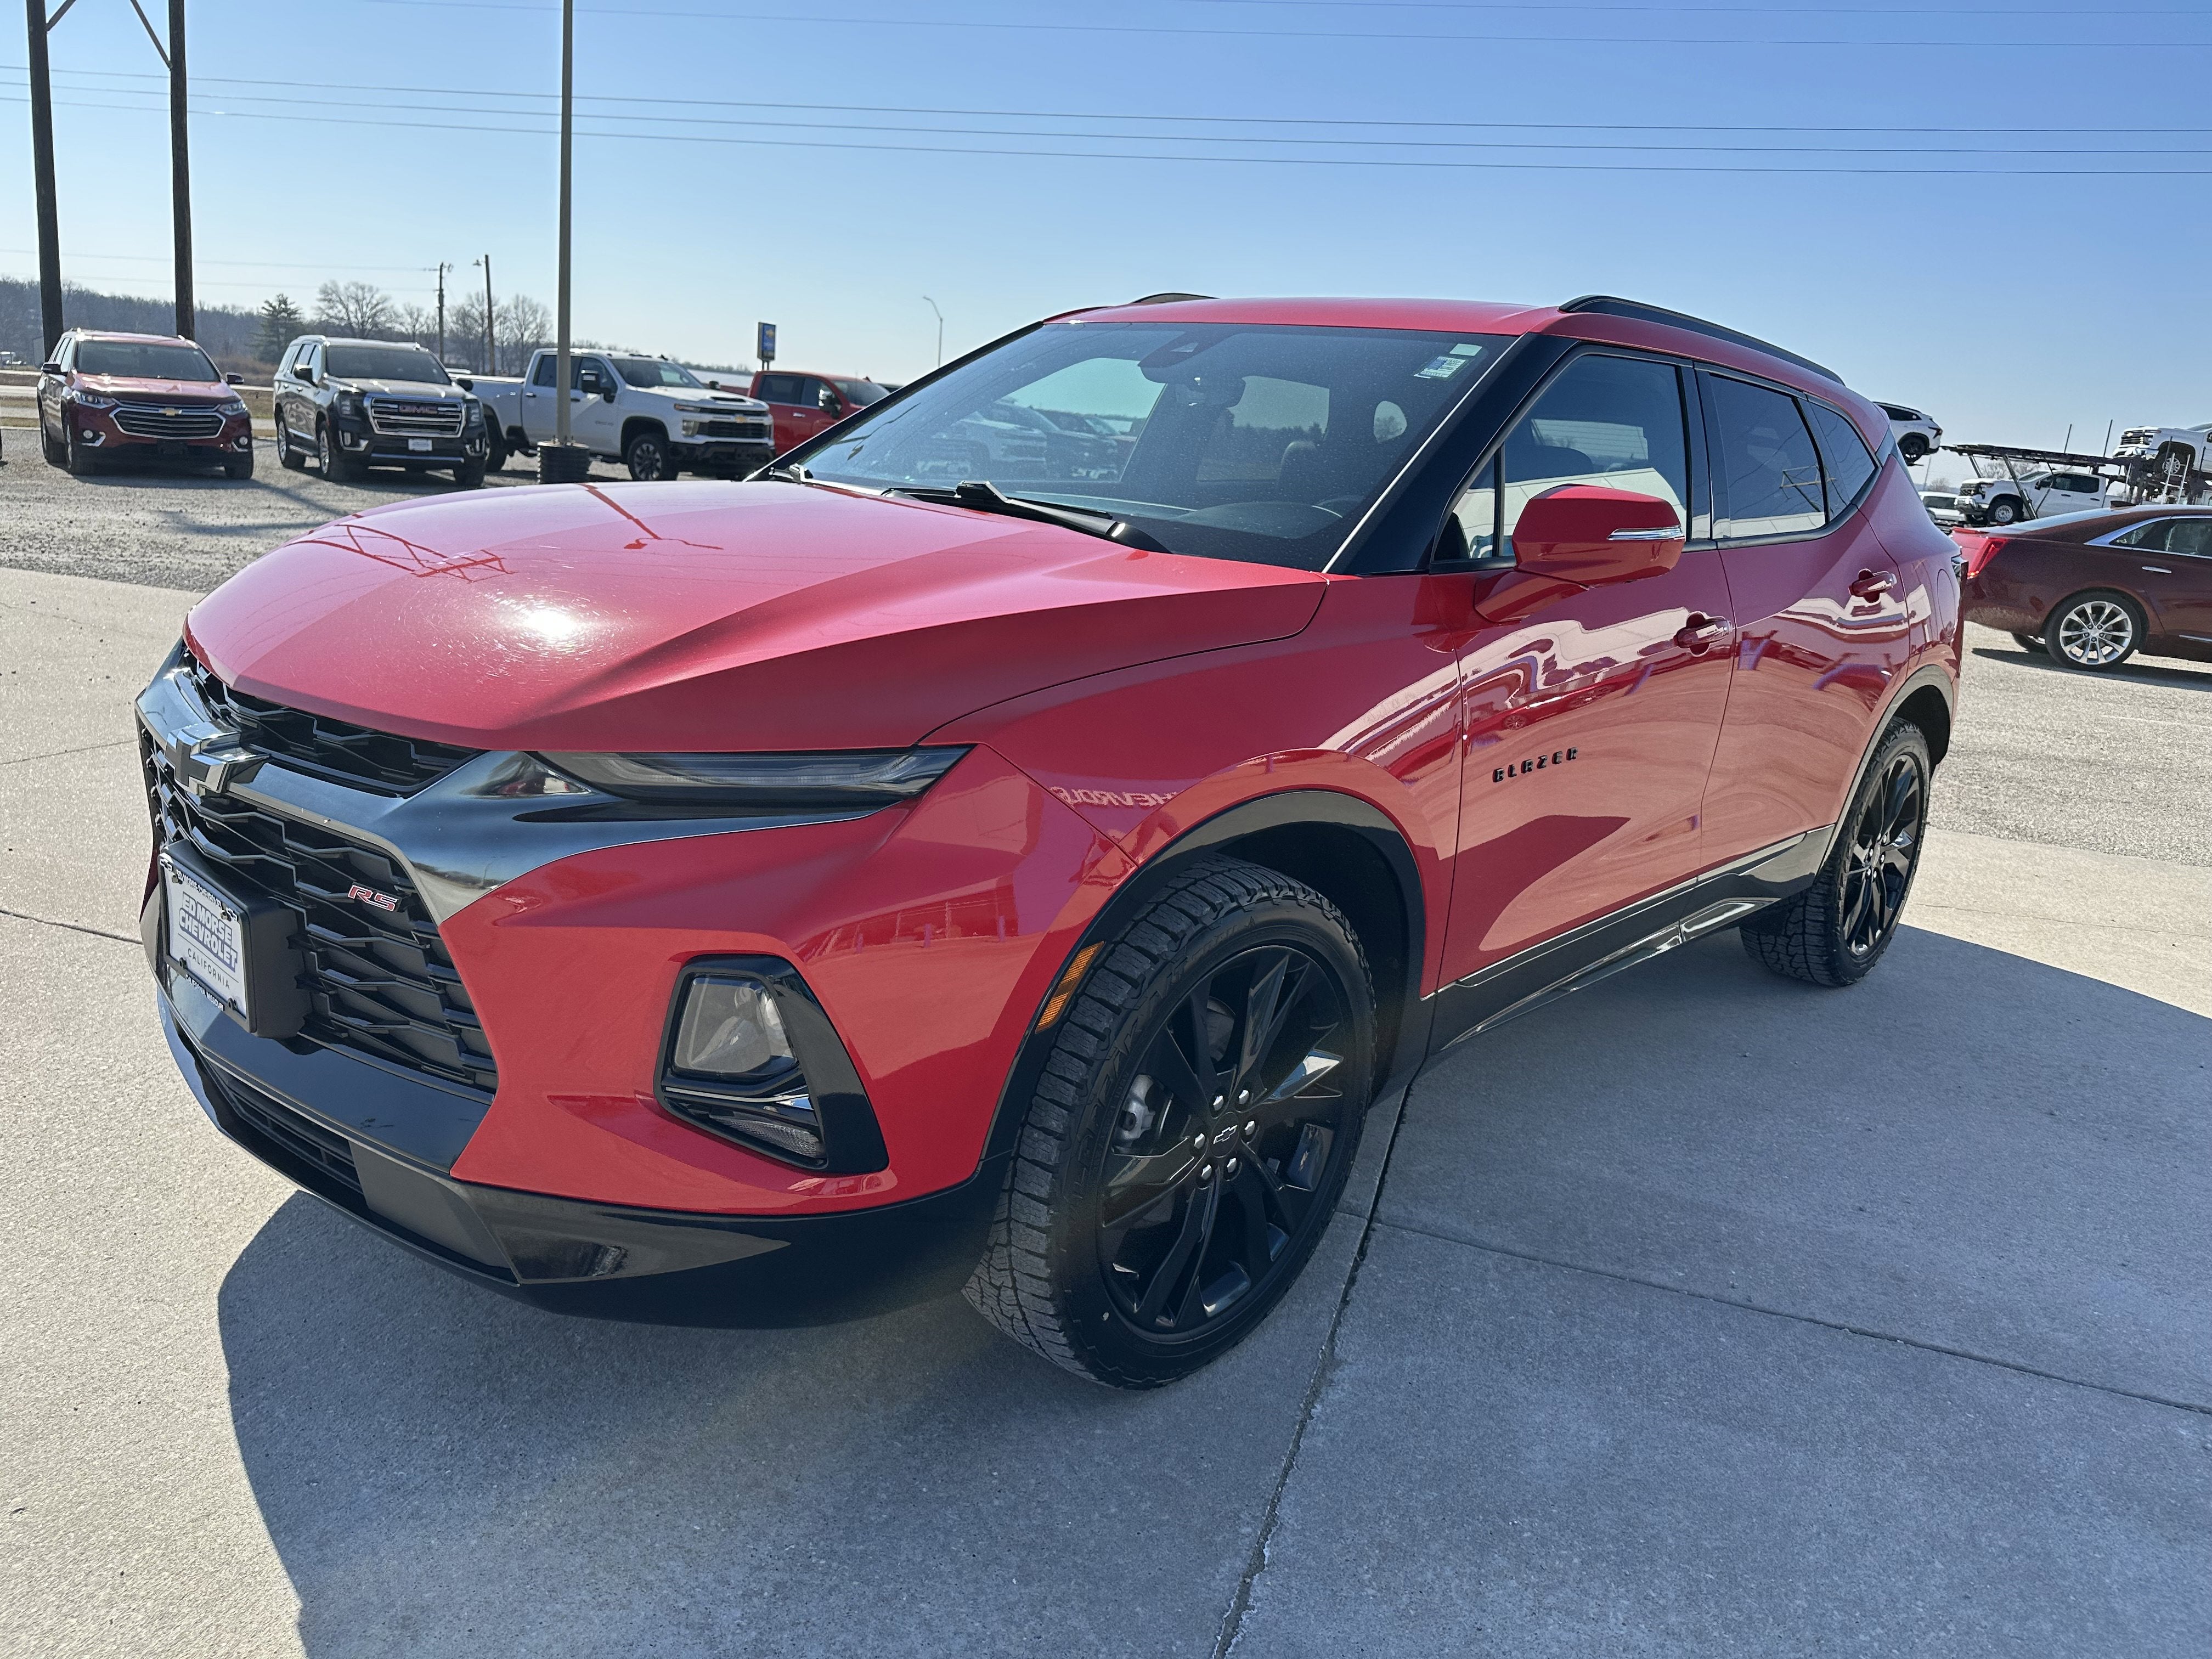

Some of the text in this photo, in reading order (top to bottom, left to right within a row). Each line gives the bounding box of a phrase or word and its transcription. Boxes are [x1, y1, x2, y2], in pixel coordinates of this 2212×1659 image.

[1492, 747, 1578, 783] BLAZER
[182, 891, 232, 946] ED MORSE
[348, 884, 399, 911] RS
[179, 908, 238, 973] CHEVROLET
[188, 947, 230, 990] CALIFORNIA
